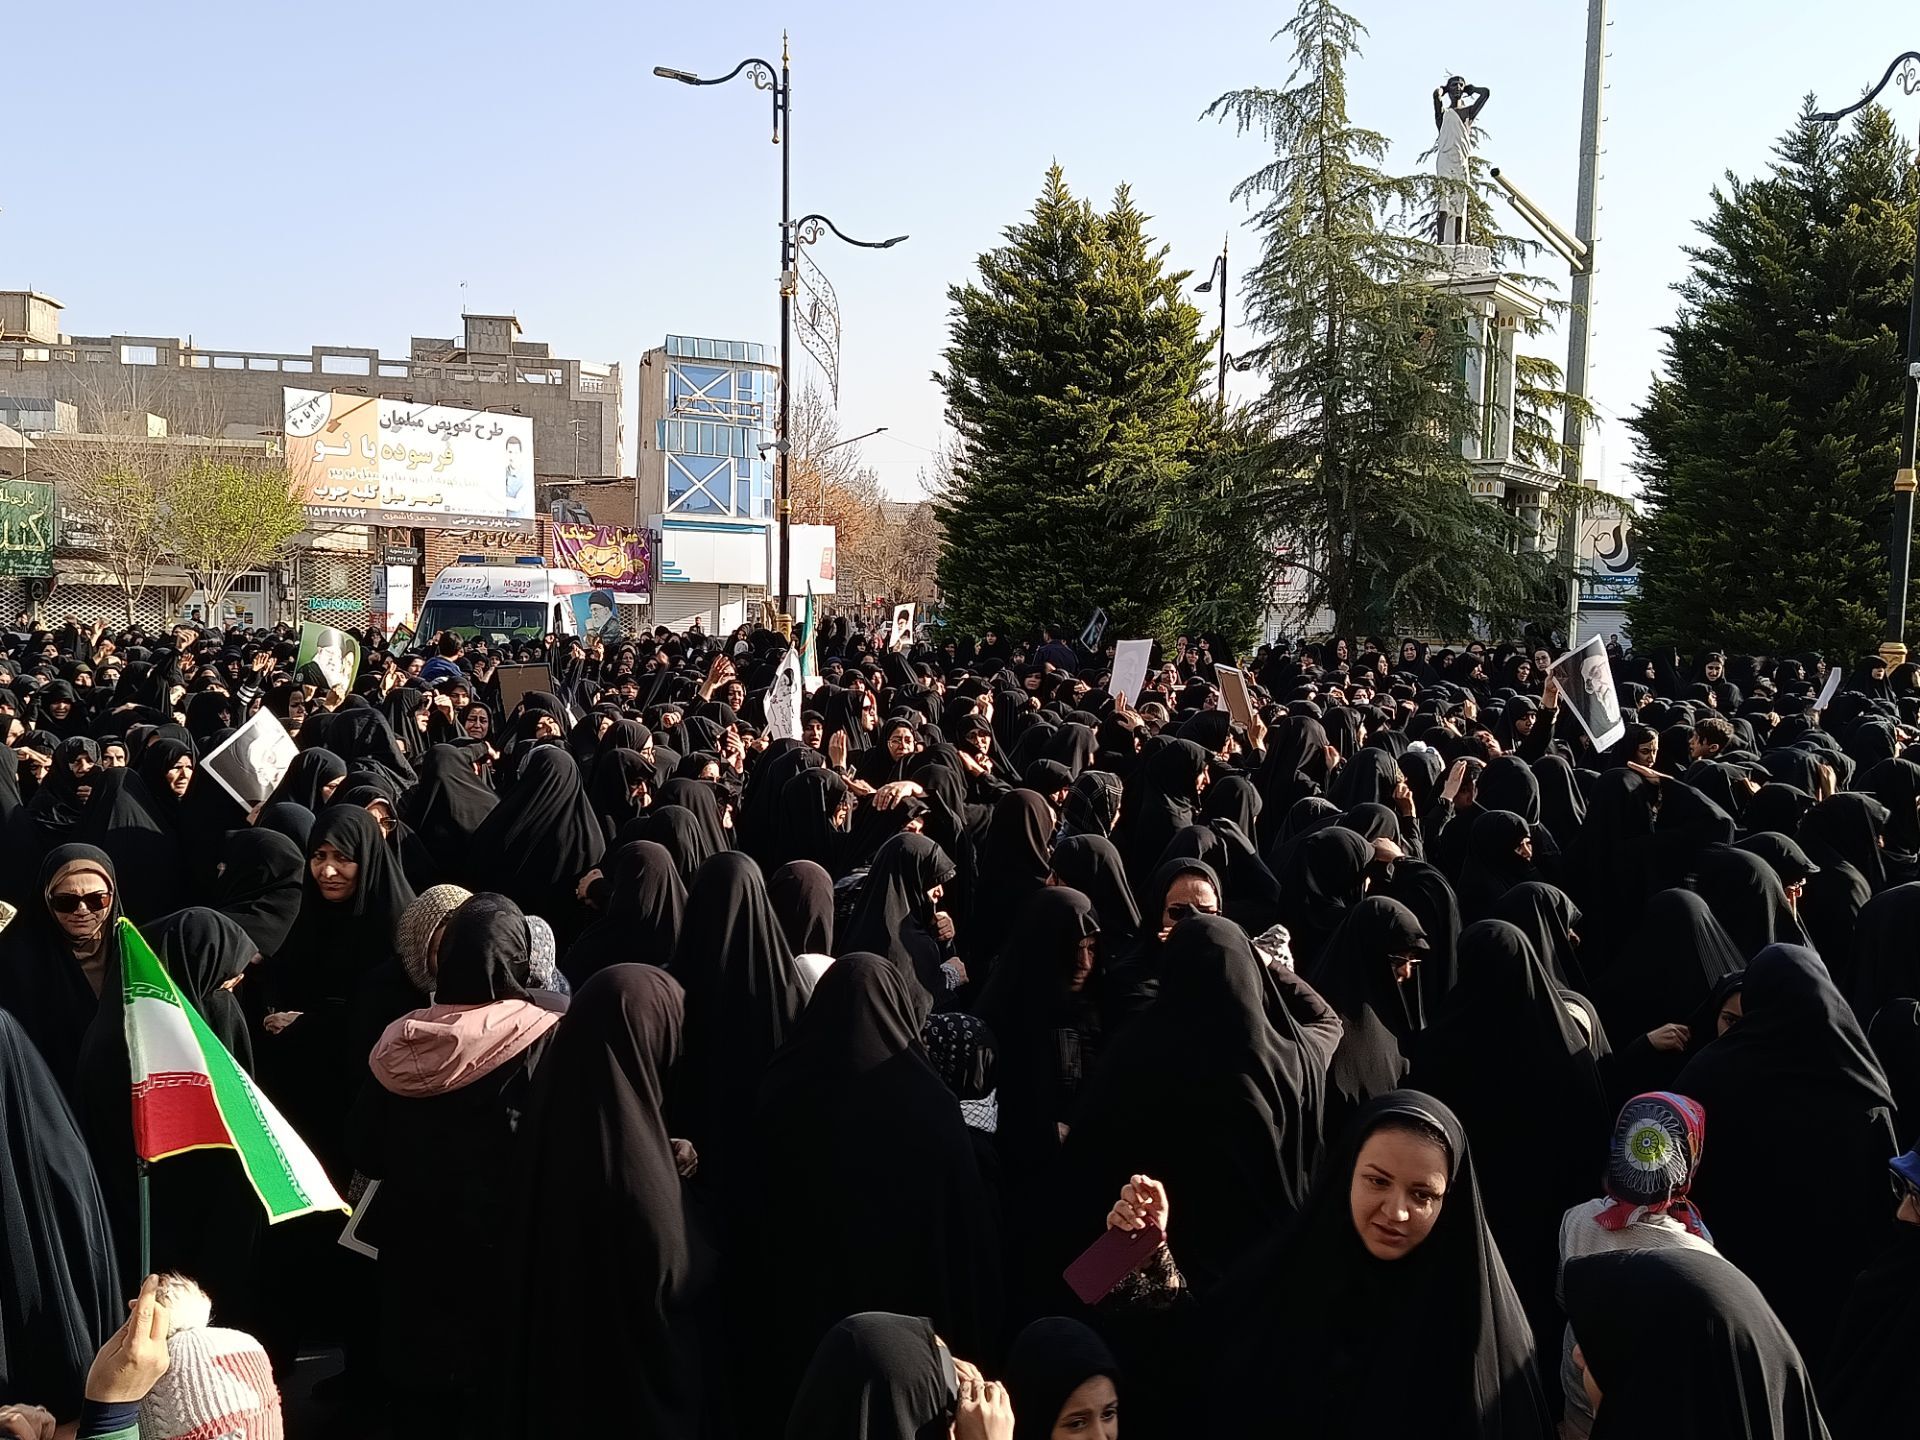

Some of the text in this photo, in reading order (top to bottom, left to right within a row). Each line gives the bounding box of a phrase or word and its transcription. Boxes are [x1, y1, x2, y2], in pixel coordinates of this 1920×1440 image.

[379, 410, 504, 440] طرح تعویض مبلمان
[312, 432, 454, 472] فرسوده با نو
[415, 514, 437, 523] محمد
[451, 584, 479, 592] اورژانس
[503, 579, 531, 588] M-3013
